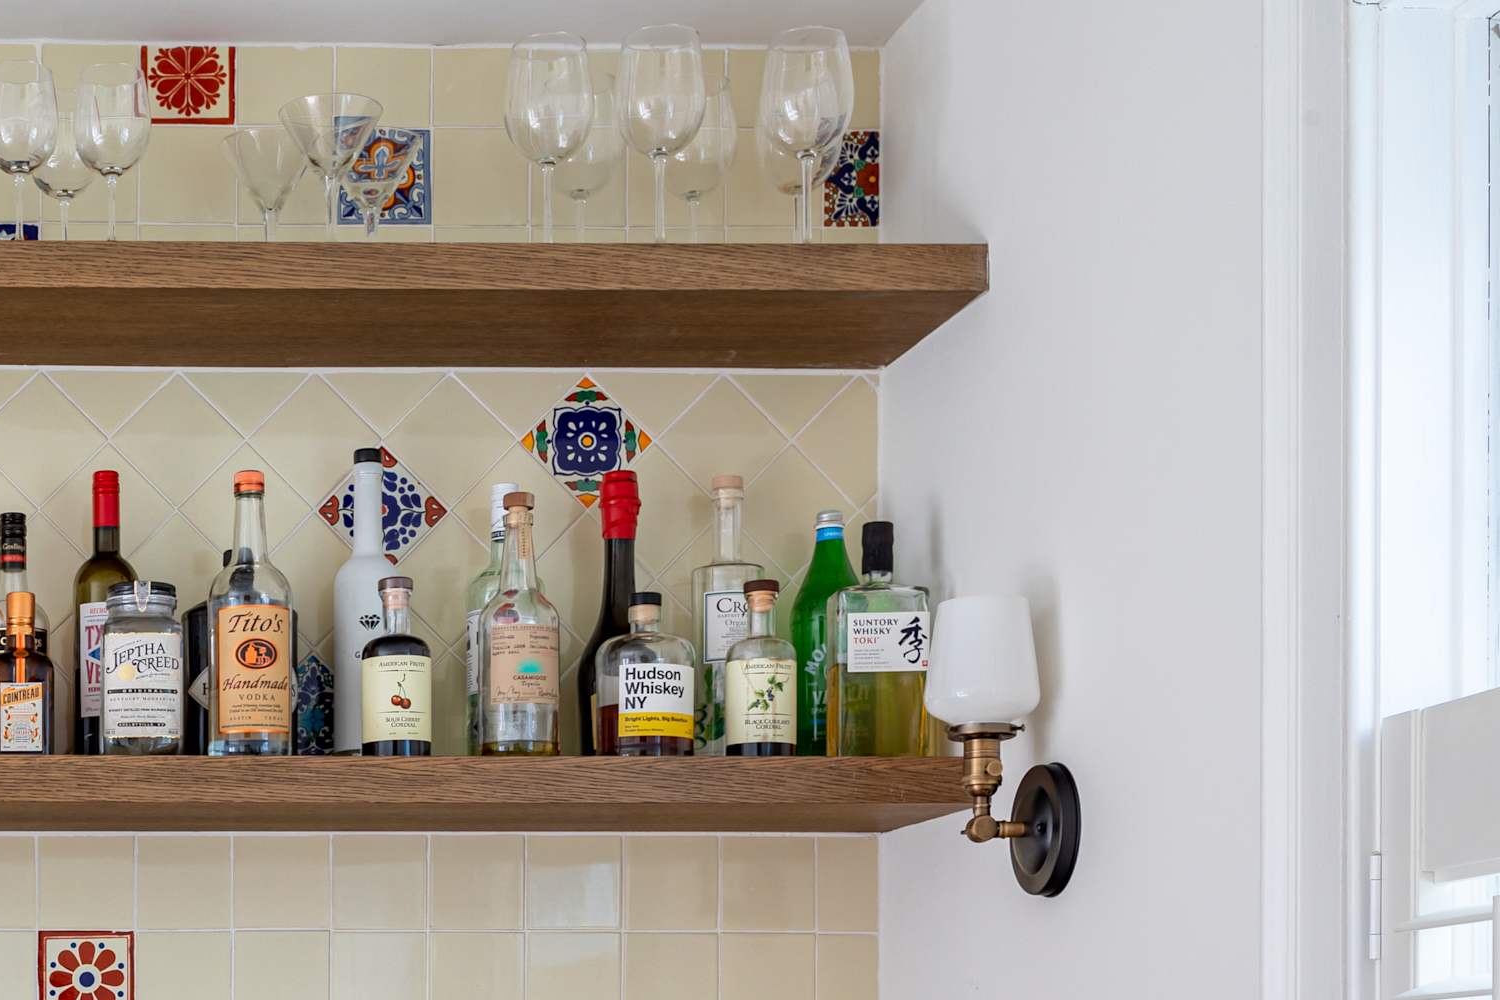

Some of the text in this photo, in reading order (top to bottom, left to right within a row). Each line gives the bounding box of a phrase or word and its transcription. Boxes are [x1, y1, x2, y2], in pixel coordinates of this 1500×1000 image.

[228, 610, 284, 634] Tito's
[853, 618, 899, 626] SUNTORY
[853, 627, 891, 635] WHISKY
[853, 636, 877, 645] TOKI
[106, 643, 165, 674] JEPTHA
[132, 656, 179, 673] CREED
[625, 667, 681, 681] Hudson
[625, 682, 684, 698] Whiskey
[239, 694, 276, 702] VODKA
[625, 696, 647, 710] NY
